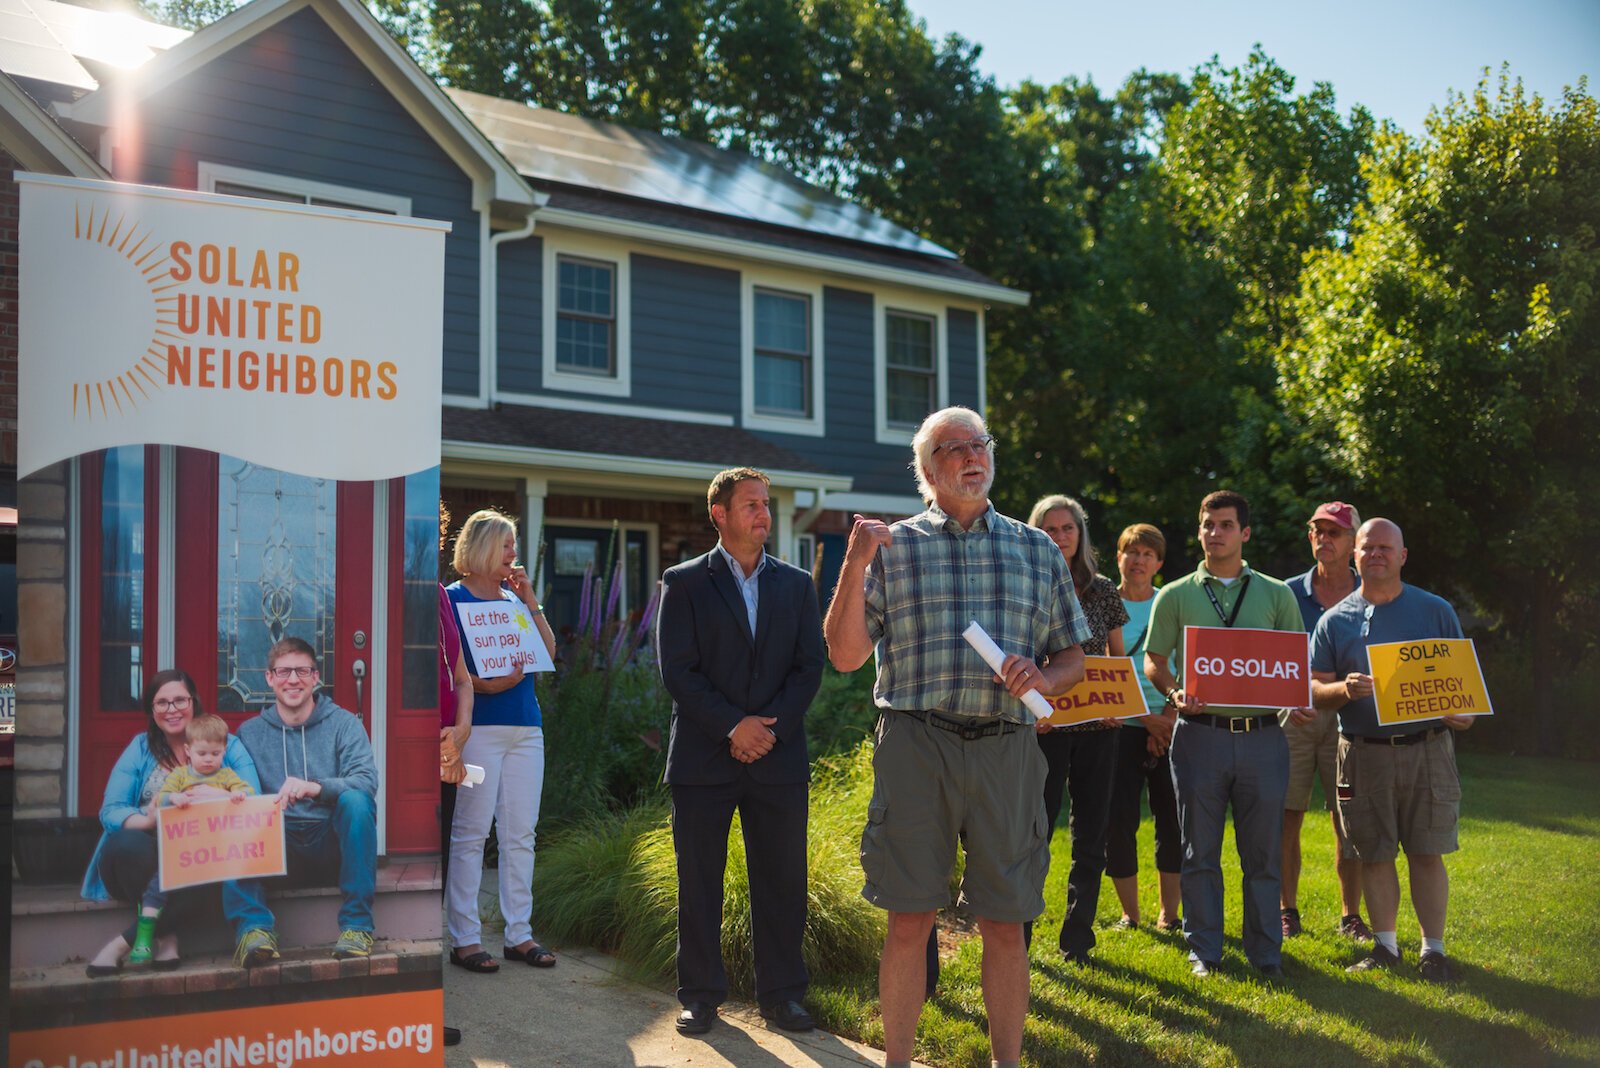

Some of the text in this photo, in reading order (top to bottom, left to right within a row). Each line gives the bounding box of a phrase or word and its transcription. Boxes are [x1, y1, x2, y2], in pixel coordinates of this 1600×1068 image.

[169, 240, 300, 293] SOLAR
[177, 293, 321, 344] UNITED
[167, 344, 398, 400] NEIGHBORS
[467, 611, 510, 626] Let the
[474, 633, 521, 649] sun pay
[1399, 643, 1450, 661] SOLAR
[481, 655, 507, 672] your
[1194, 656, 1300, 680] GO SOLAR
[1080, 668, 1130, 683] ENT
[1400, 677, 1464, 698] ENERGY
[1395, 694, 1475, 716] FREEDOM
[165, 810, 277, 841] WE WENT
[178, 841, 265, 868] SOLAR!
